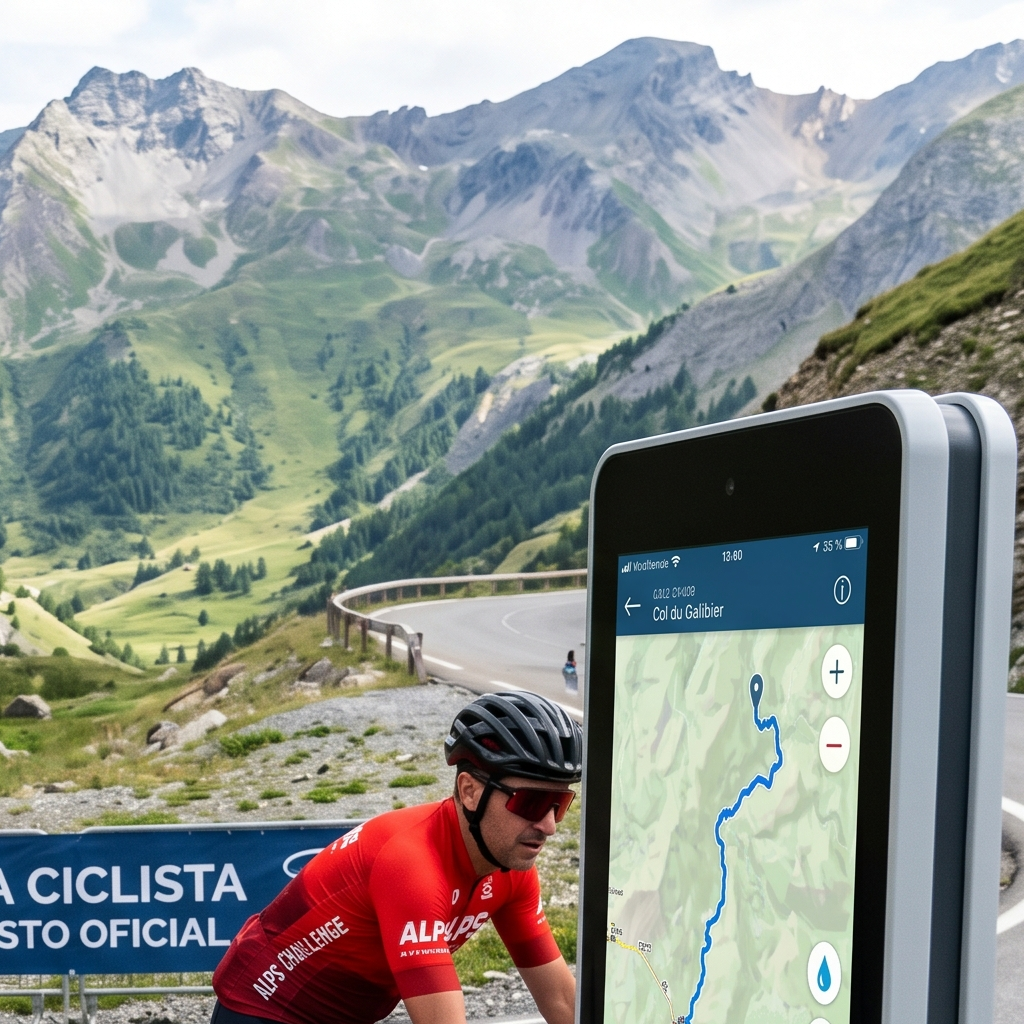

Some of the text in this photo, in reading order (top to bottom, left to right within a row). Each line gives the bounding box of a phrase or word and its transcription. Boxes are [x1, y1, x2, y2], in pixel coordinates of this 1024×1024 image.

[652, 602, 724, 621] Col du Galibier
[27, 862, 248, 904] CICLISTA
[80, 916, 231, 949] OFICIAL
[252, 964, 286, 1001] ALPS
